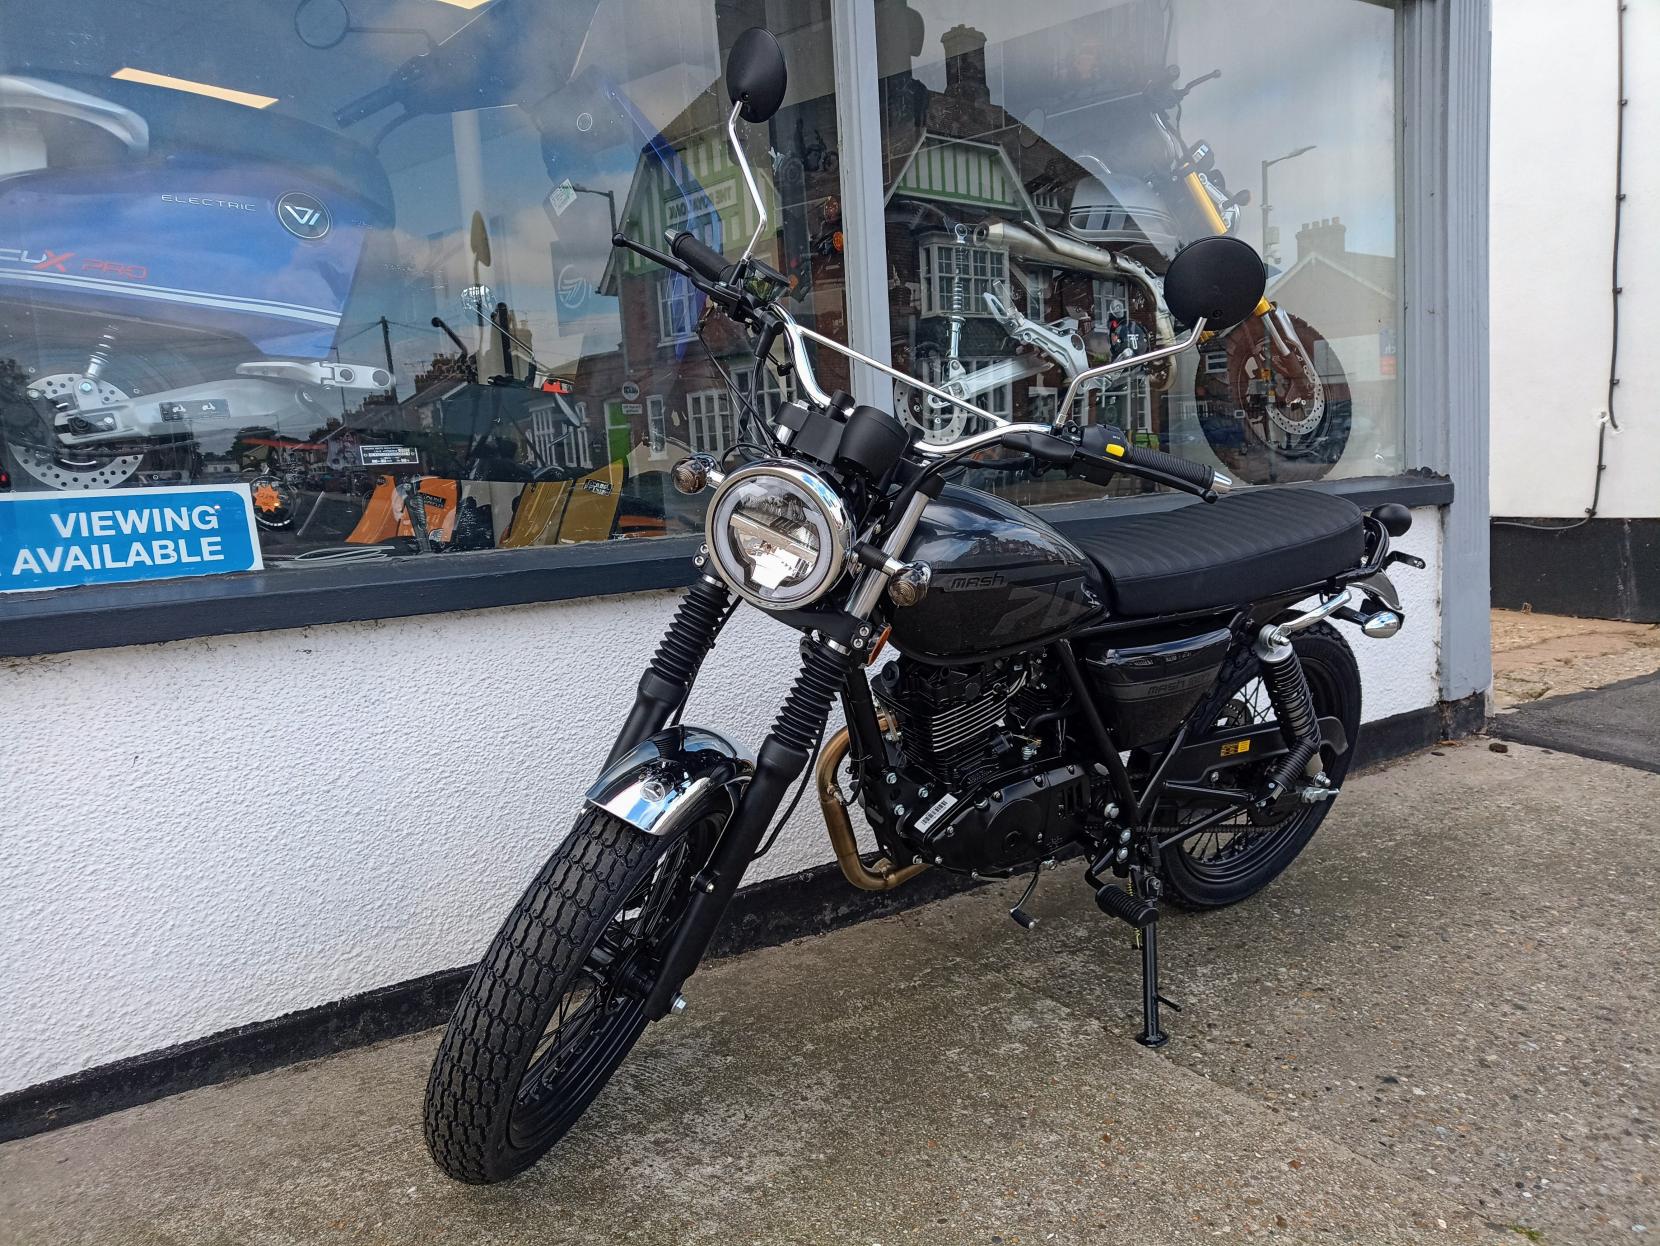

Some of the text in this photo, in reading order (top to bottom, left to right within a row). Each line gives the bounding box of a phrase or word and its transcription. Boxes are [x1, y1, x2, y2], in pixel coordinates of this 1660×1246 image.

[161, 193, 257, 212] ELECTRIC
[81, 258, 148, 280] PRO
[50, 505, 219, 538] VIEWING
[12, 536, 225, 576] AVAILABLE
